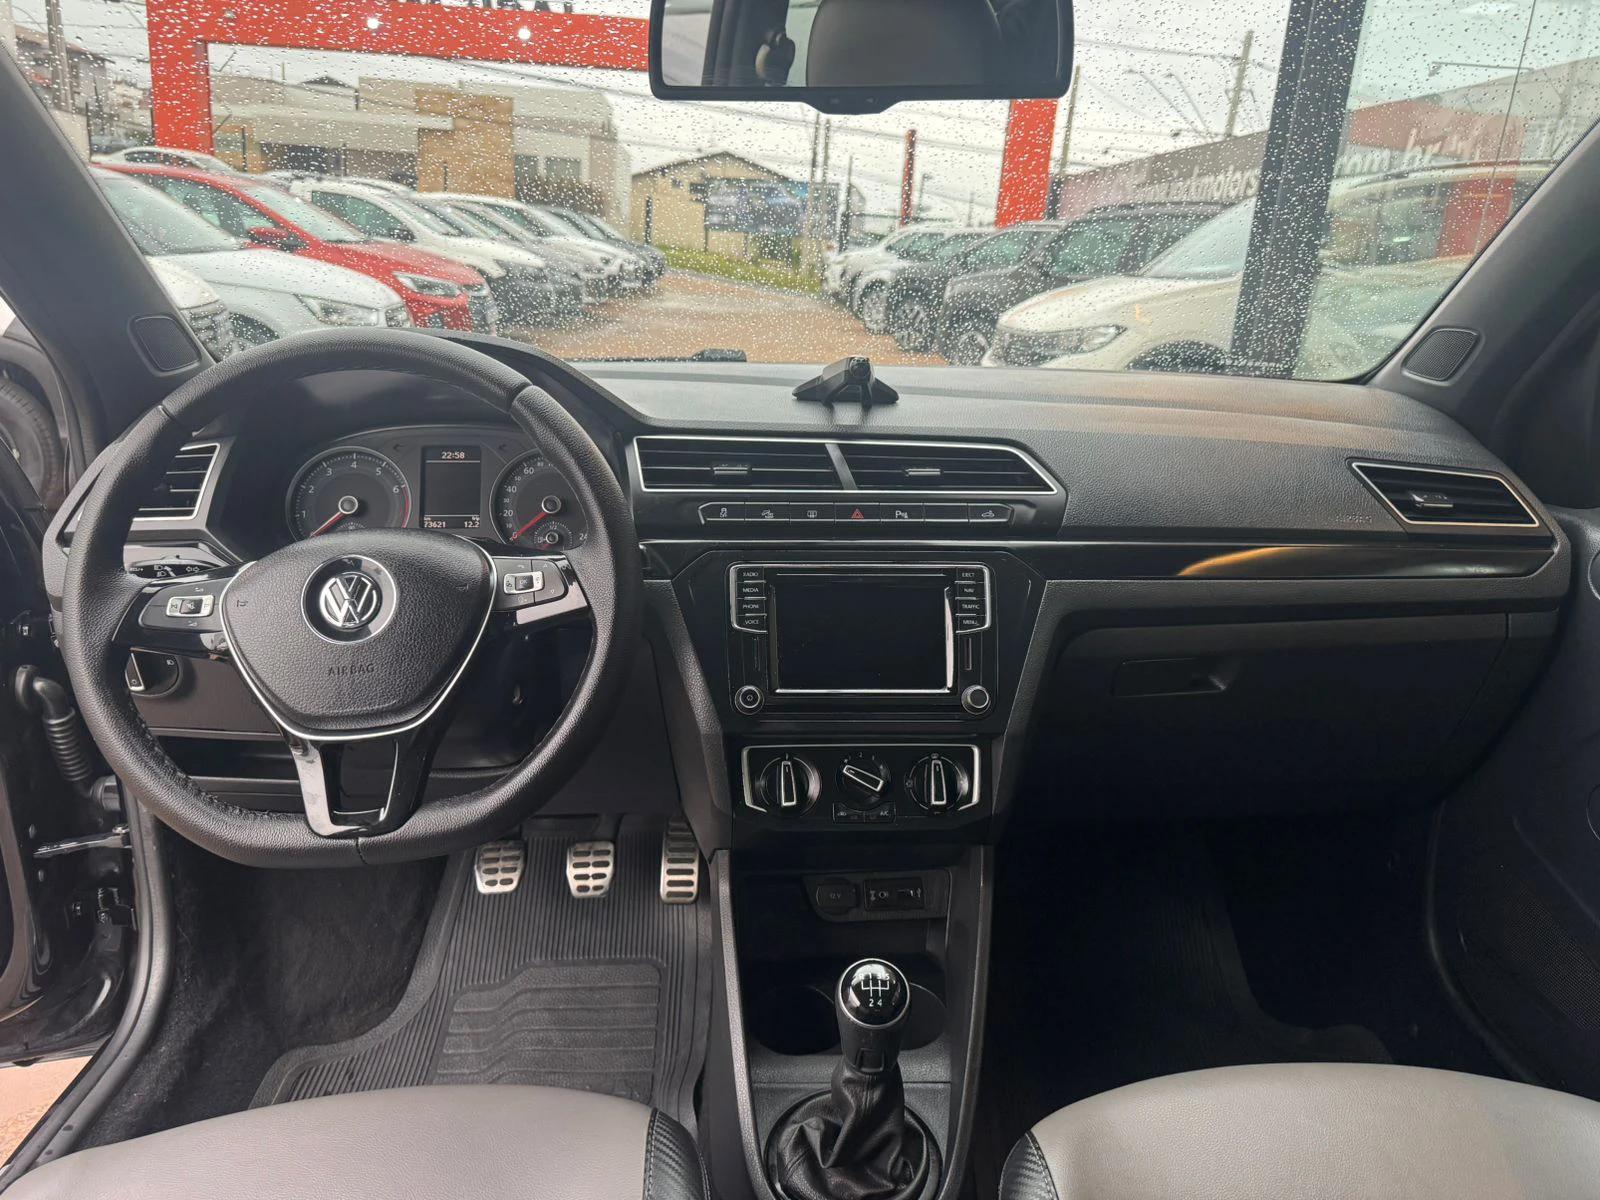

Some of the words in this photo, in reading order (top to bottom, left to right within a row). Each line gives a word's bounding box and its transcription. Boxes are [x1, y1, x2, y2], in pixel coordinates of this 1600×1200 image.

[441, 451, 465, 459] 22:58
[326, 467, 332, 476] 3
[375, 467, 381, 476] 5
[523, 467, 535, 475] 60
[308, 485, 314, 493] 2
[392, 485, 399, 493] 6
[506, 485, 517, 493] 40
[301, 510, 306, 518] 1
[502, 509, 514, 517] 20
[328, 663, 375, 676] AIRBAG
[884, 972, 890, 980] 5
[868, 998, 875, 1007] 2
[877, 998, 883, 1007] 4
